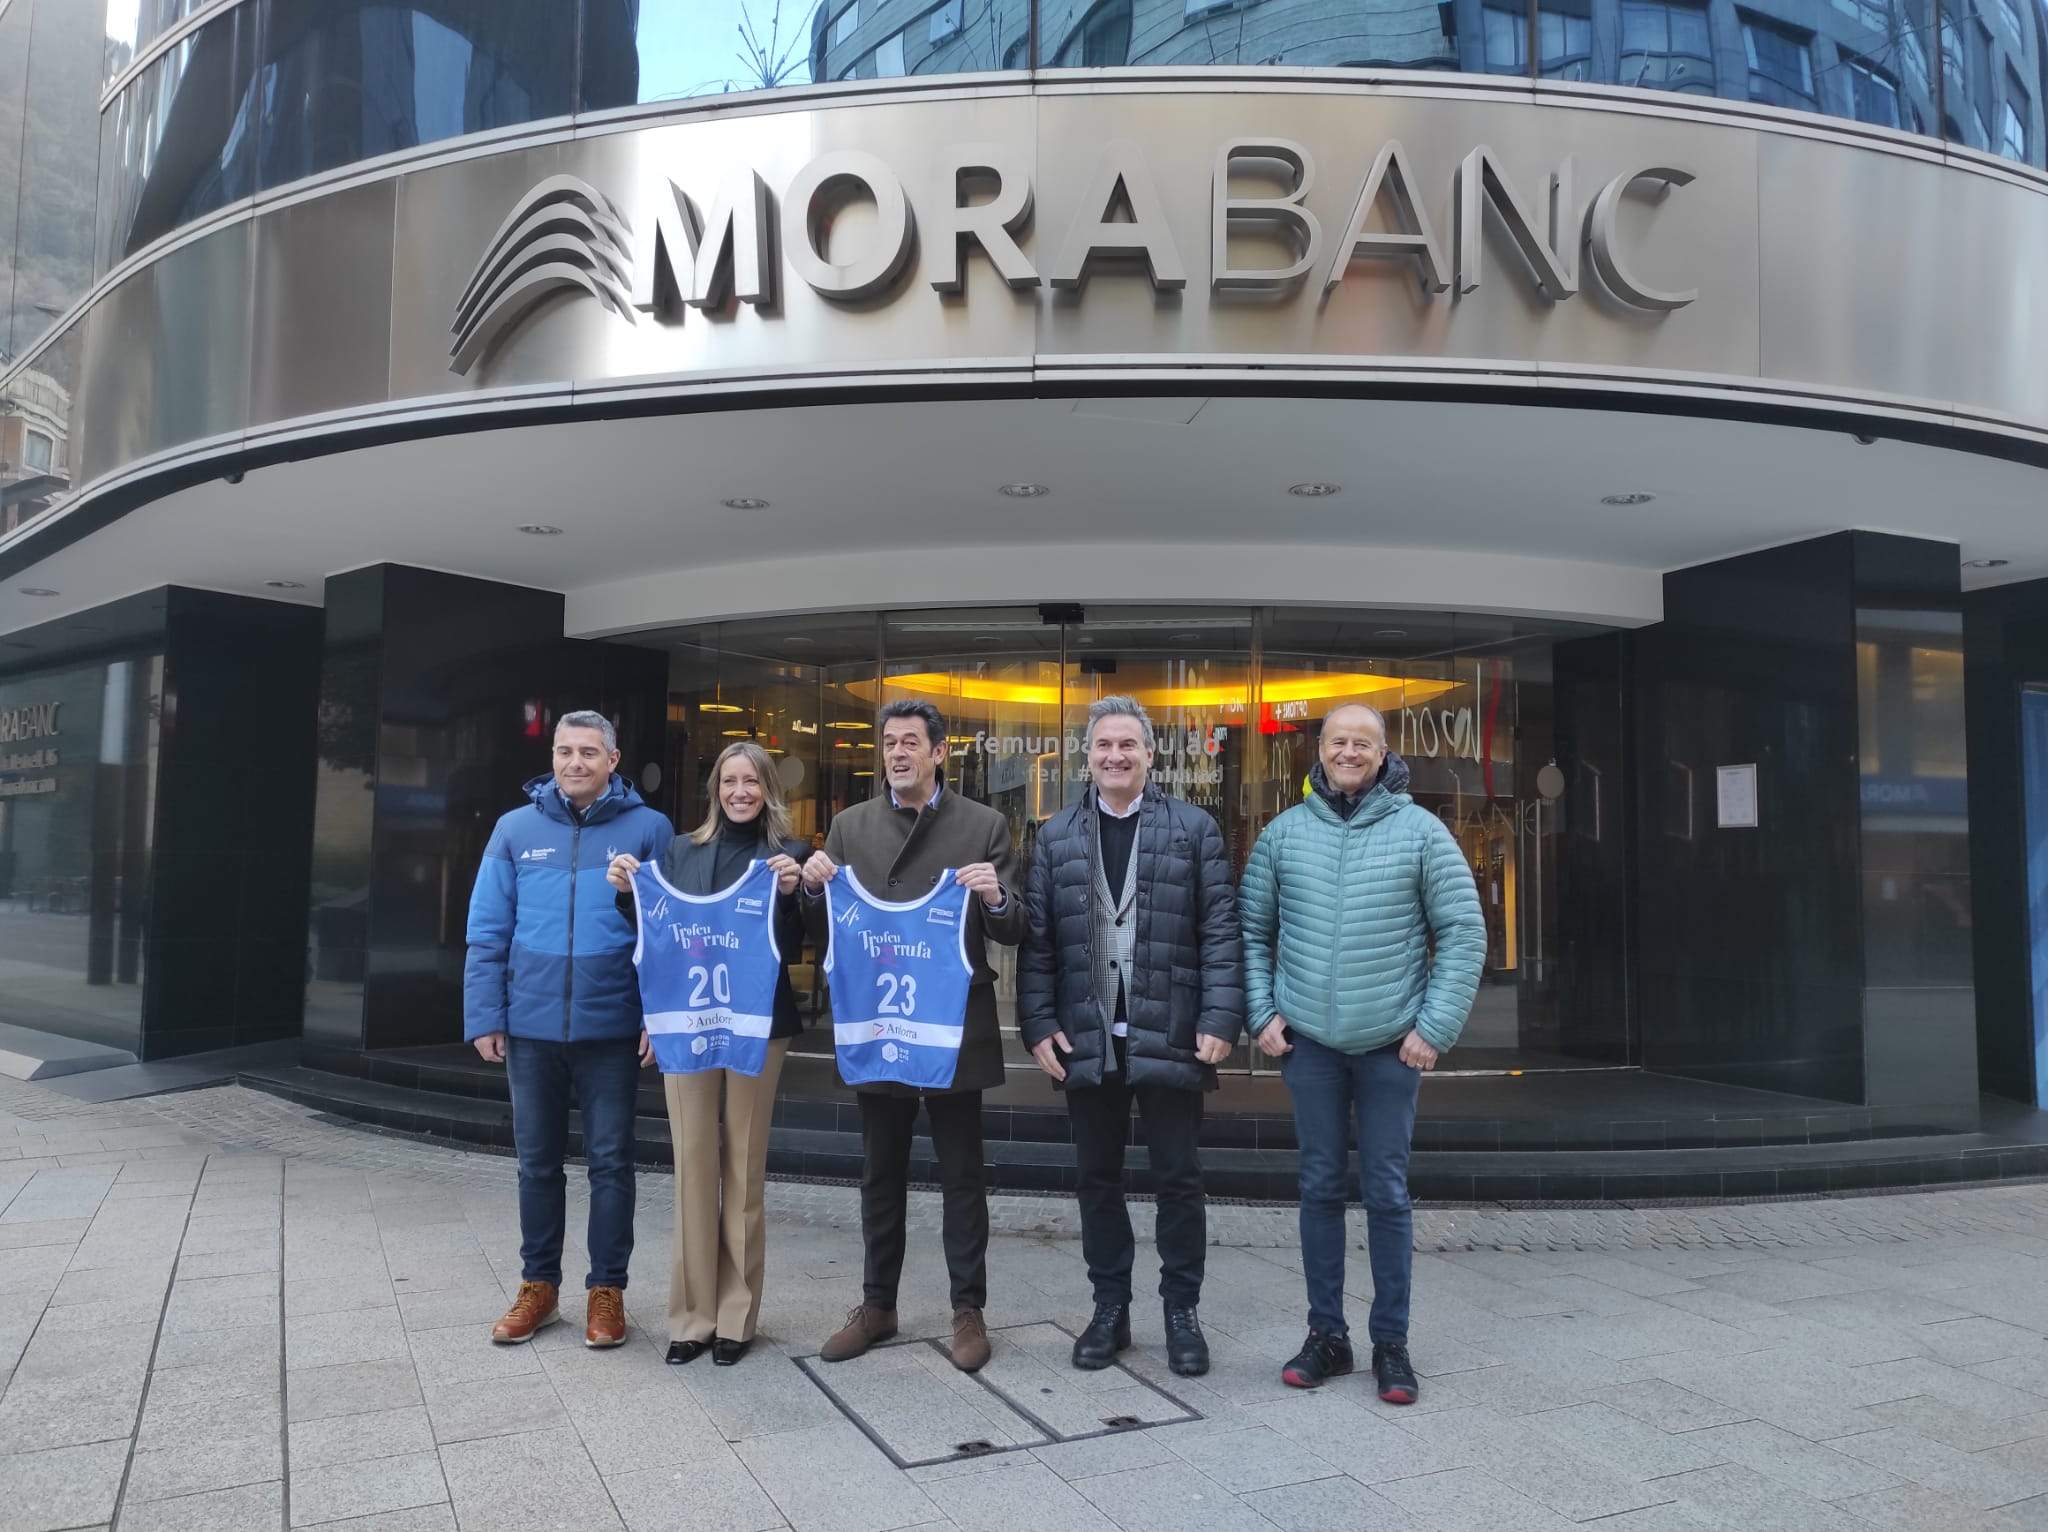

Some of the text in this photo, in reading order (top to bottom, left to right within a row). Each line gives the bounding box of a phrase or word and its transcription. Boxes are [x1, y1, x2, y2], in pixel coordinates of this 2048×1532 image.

[632, 137, 1699, 312] MORABANC
[0, 702, 60, 742] RABANC
[688, 963, 731, 1008] 20
[876, 972, 917, 1016] 23
